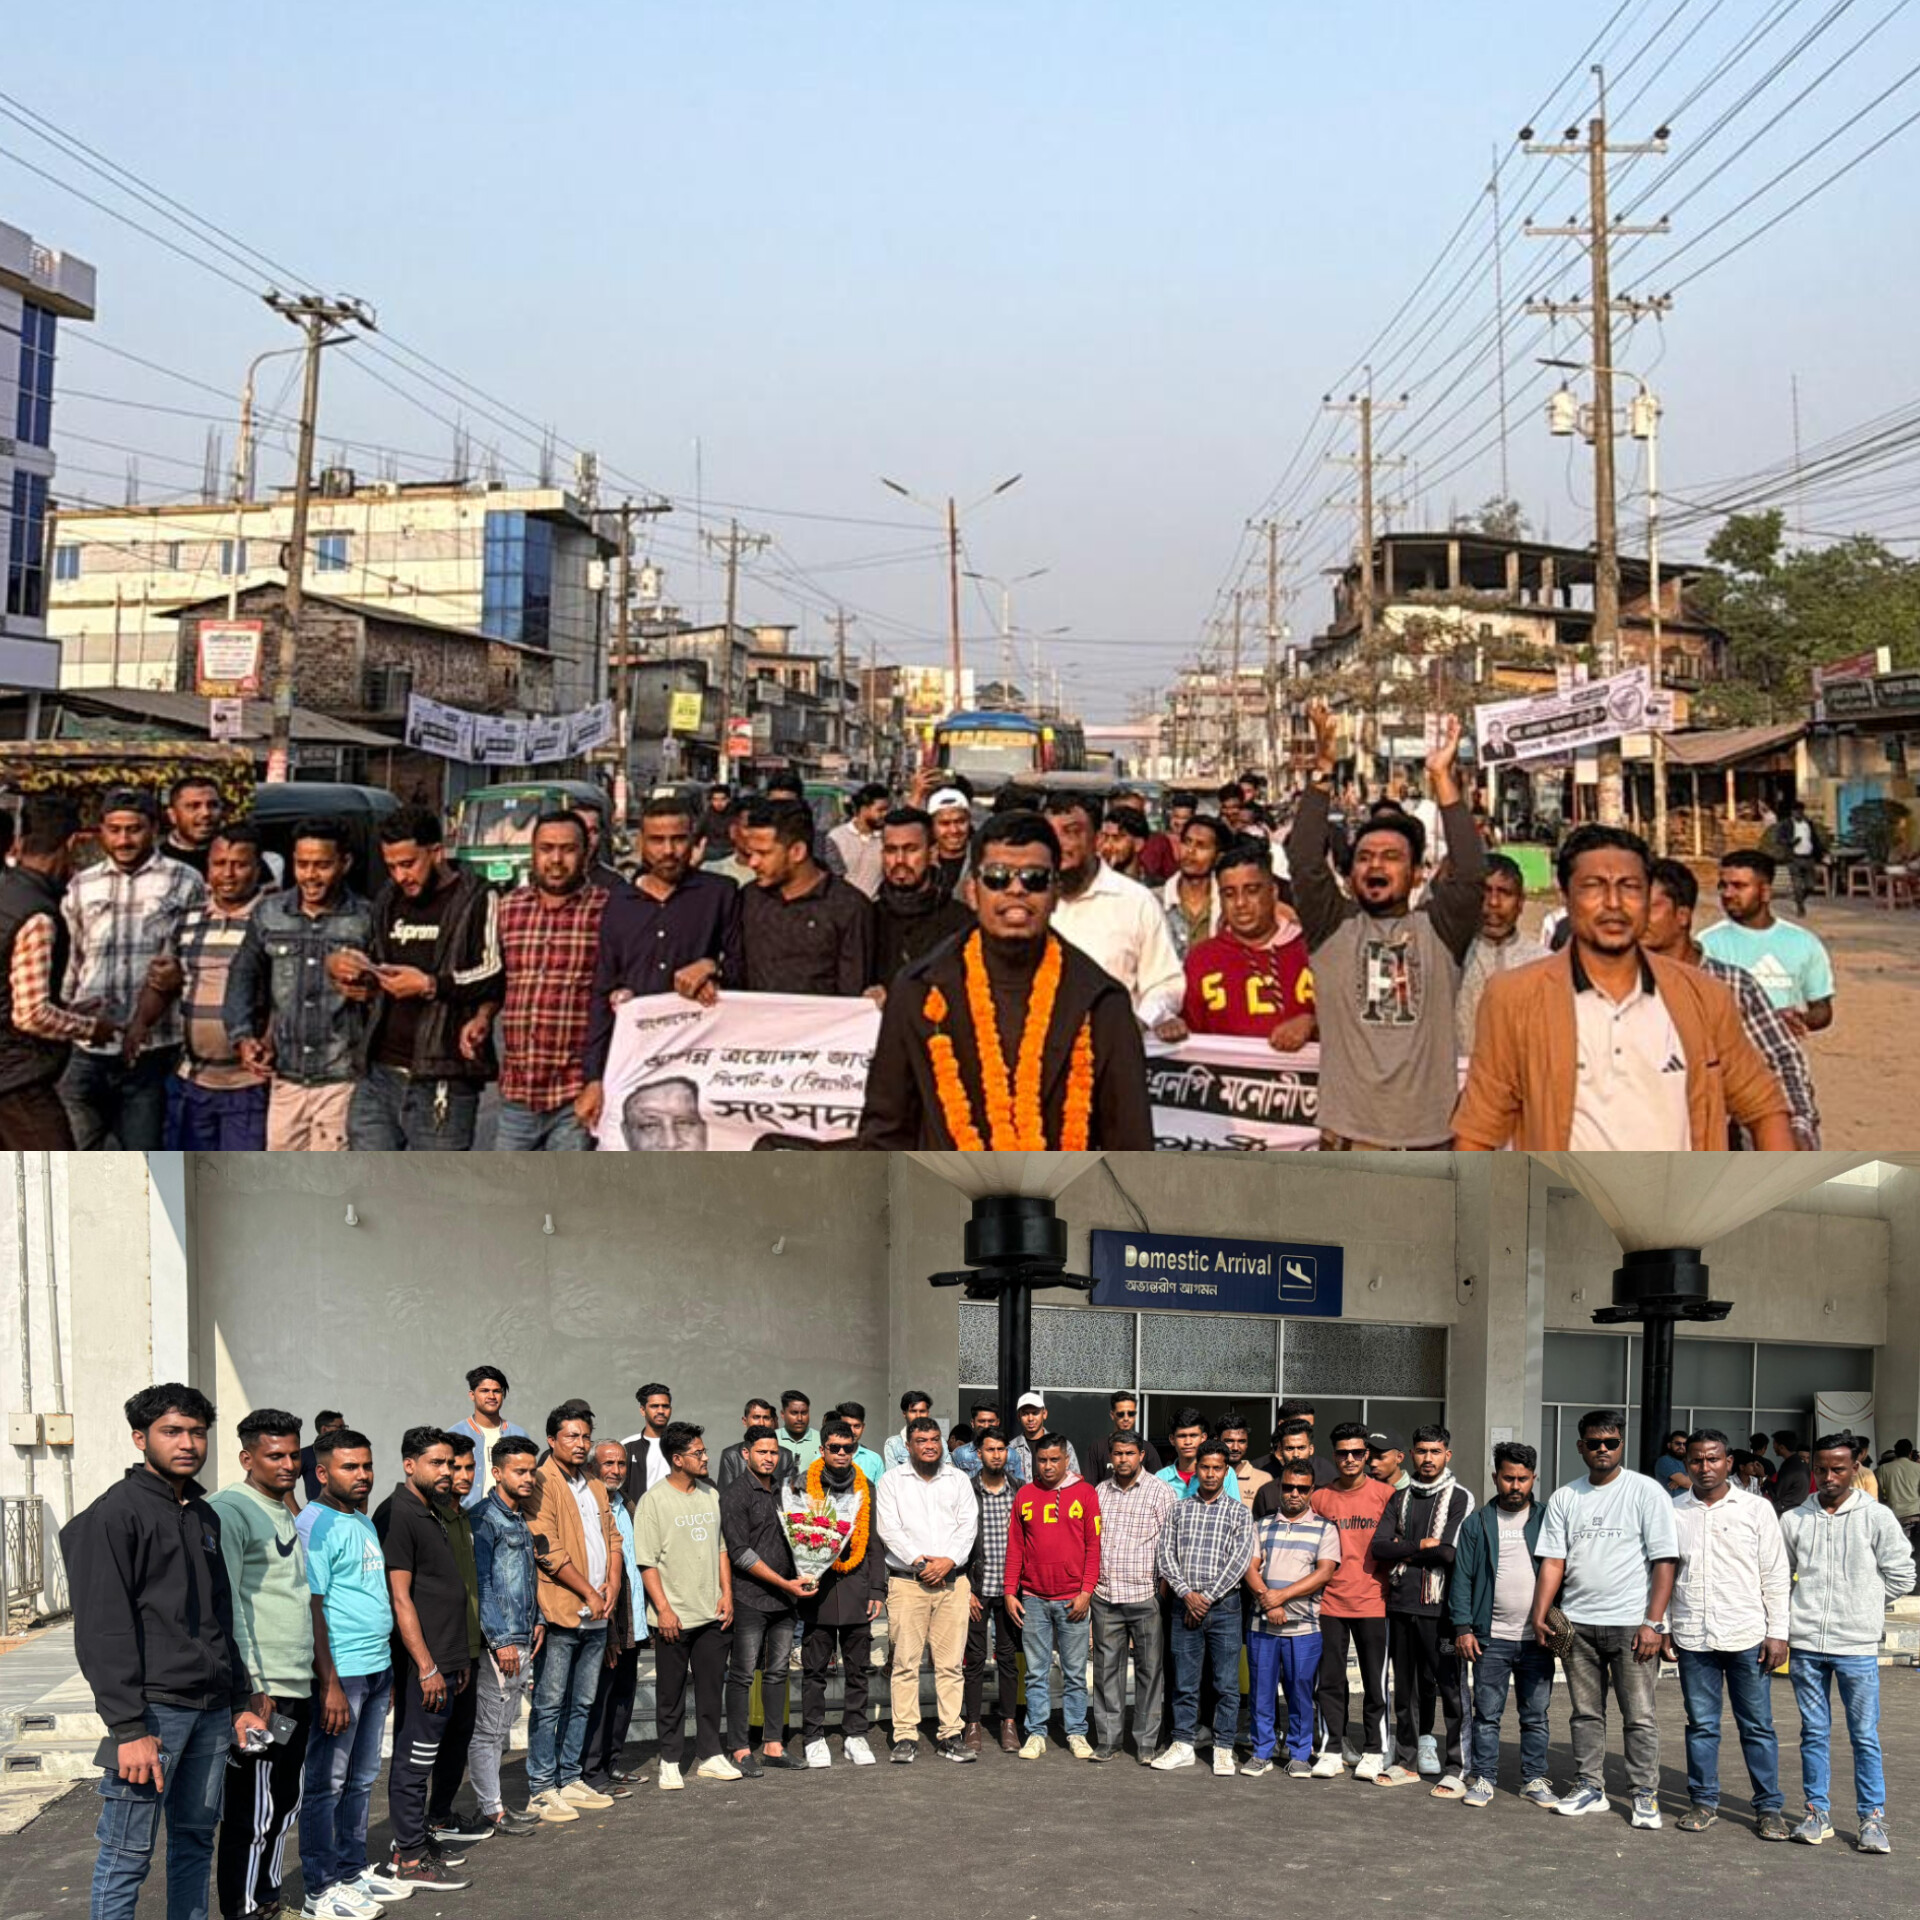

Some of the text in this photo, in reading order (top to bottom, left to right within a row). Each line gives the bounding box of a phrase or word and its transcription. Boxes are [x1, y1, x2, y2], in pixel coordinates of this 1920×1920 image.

[1147, 1064, 1319, 1120] এনপি মনোনীত
[710, 1099, 865, 1131] সংসদ
[1125, 1244, 1272, 1276] Domestic Arrival
[1125, 1277, 1218, 1297] অভ্যন্তরীণ আগমন
[674, 1511, 716, 1527] GUCCI
